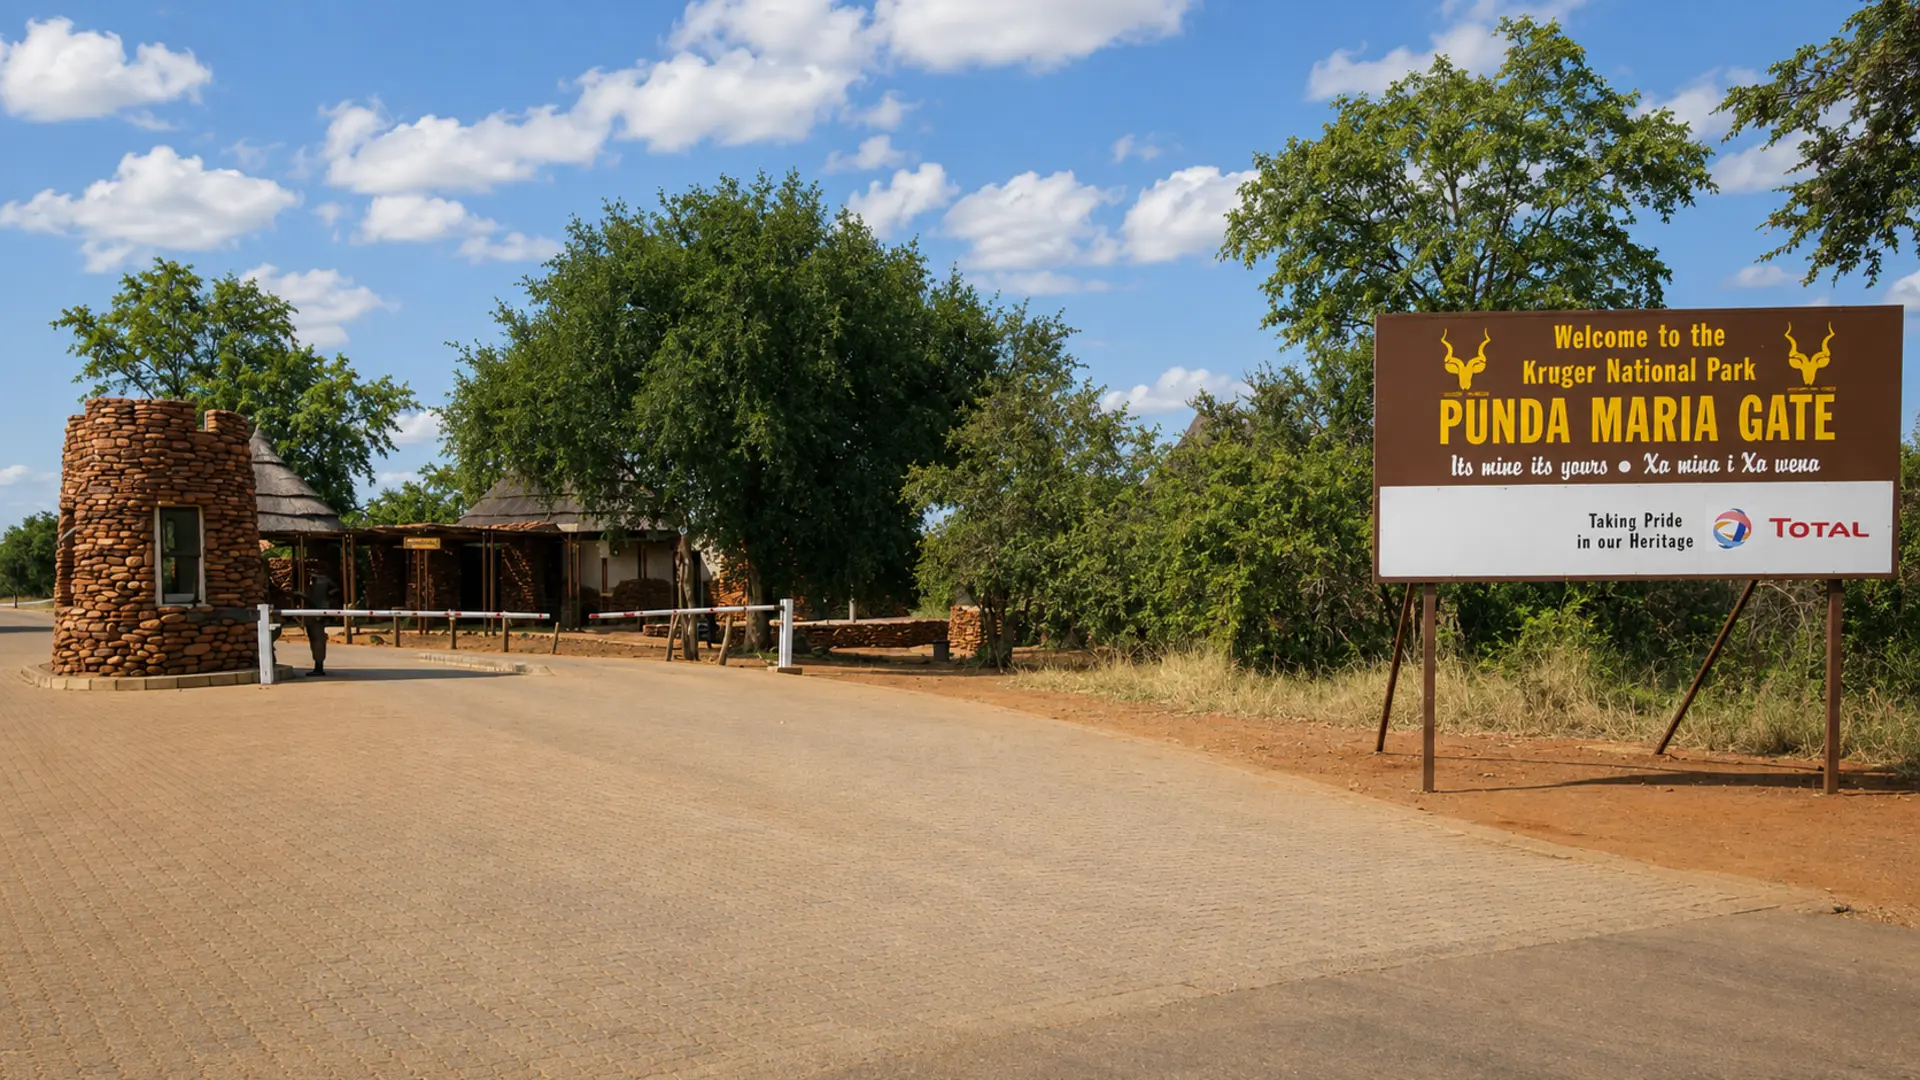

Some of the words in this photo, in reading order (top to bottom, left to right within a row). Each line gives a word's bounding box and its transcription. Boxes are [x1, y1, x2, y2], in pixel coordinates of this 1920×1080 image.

[1554, 324, 1648, 349] Welcome
[1658, 324, 1680, 348] to
[1690, 322, 1725, 347] the
[1523, 360, 1596, 388] Kruger
[1606, 357, 1697, 384] National
[1707, 356, 1756, 382] Park
[1439, 398, 1571, 445] PUNDA
[1591, 395, 1719, 443] MARIA
[1738, 393, 1836, 442] GATE
[1451, 454, 1474, 477] Its
[1481, 457, 1523, 477] mine
[1531, 456, 1553, 476] its
[1561, 459, 1608, 481] yours
[1643, 452, 1671, 475] Xa
[1677, 454, 1721, 474] mina
[1727, 454, 1735, 473] i
[1741, 451, 1768, 474] Xa
[1774, 457, 1821, 474] wena
[1588, 512, 1637, 532] Taking
[1644, 512, 1683, 529] Pride
[1768, 517, 1870, 539] TOTAL
[1577, 534, 1590, 550] in
[1597, 537, 1623, 550] our
[1629, 532, 1694, 552] Heritage
